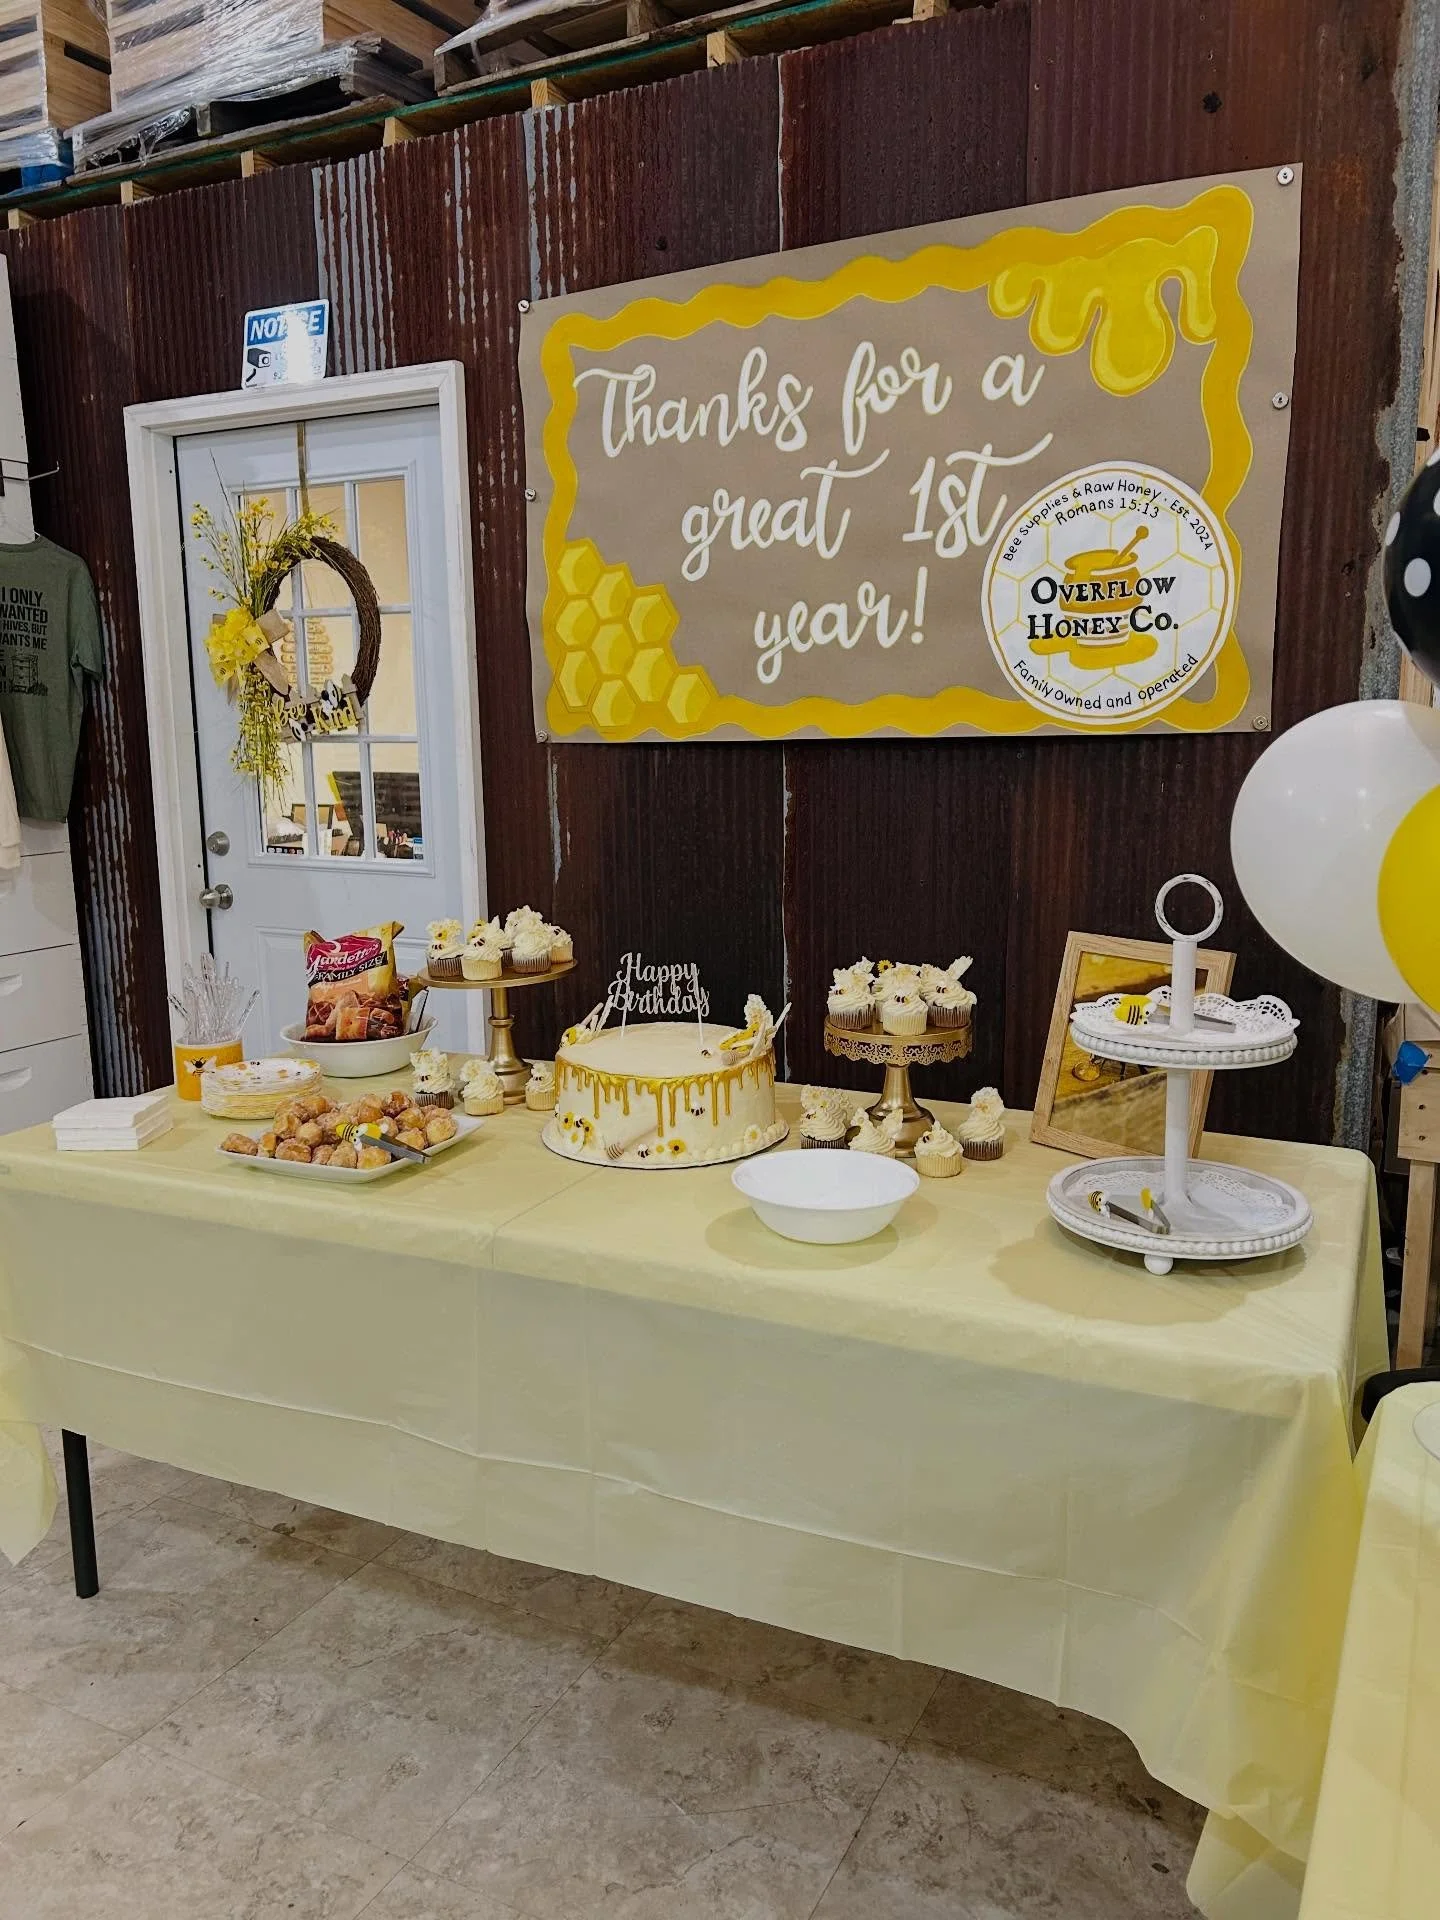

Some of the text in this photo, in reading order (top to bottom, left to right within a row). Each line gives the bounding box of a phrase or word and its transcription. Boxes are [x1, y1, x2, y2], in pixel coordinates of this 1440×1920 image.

[573, 340, 1046, 458] Thanks for a
[681, 432, 1054, 582] great 1st
[1003, 536, 1022, 562] Bee
[1019, 492, 1069, 536] Supplies
[1072, 487, 1083, 499] &
[1084, 479, 1115, 496] Raw
[1117, 479, 1162, 503] Honey
[1055, 497, 1160, 526] Romans 15:13
[10, 587, 43, 607] ONLY
[1031, 576, 1176, 605] OVERFLOW
[0, 632, 48, 650] ANTS ME
[31, 622, 47, 636] BUT
[753, 566, 928, 684] year!
[1027, 613, 1123, 640] HONEY
[1013, 658, 1054, 699] Family
[1106, 692, 1132, 709] and
[1137, 653, 1199, 702] operated
[317, 967, 357, 981] FAMILY
[616, 952, 700, 996] Happy
[608, 980, 710, 1017] Birthday
